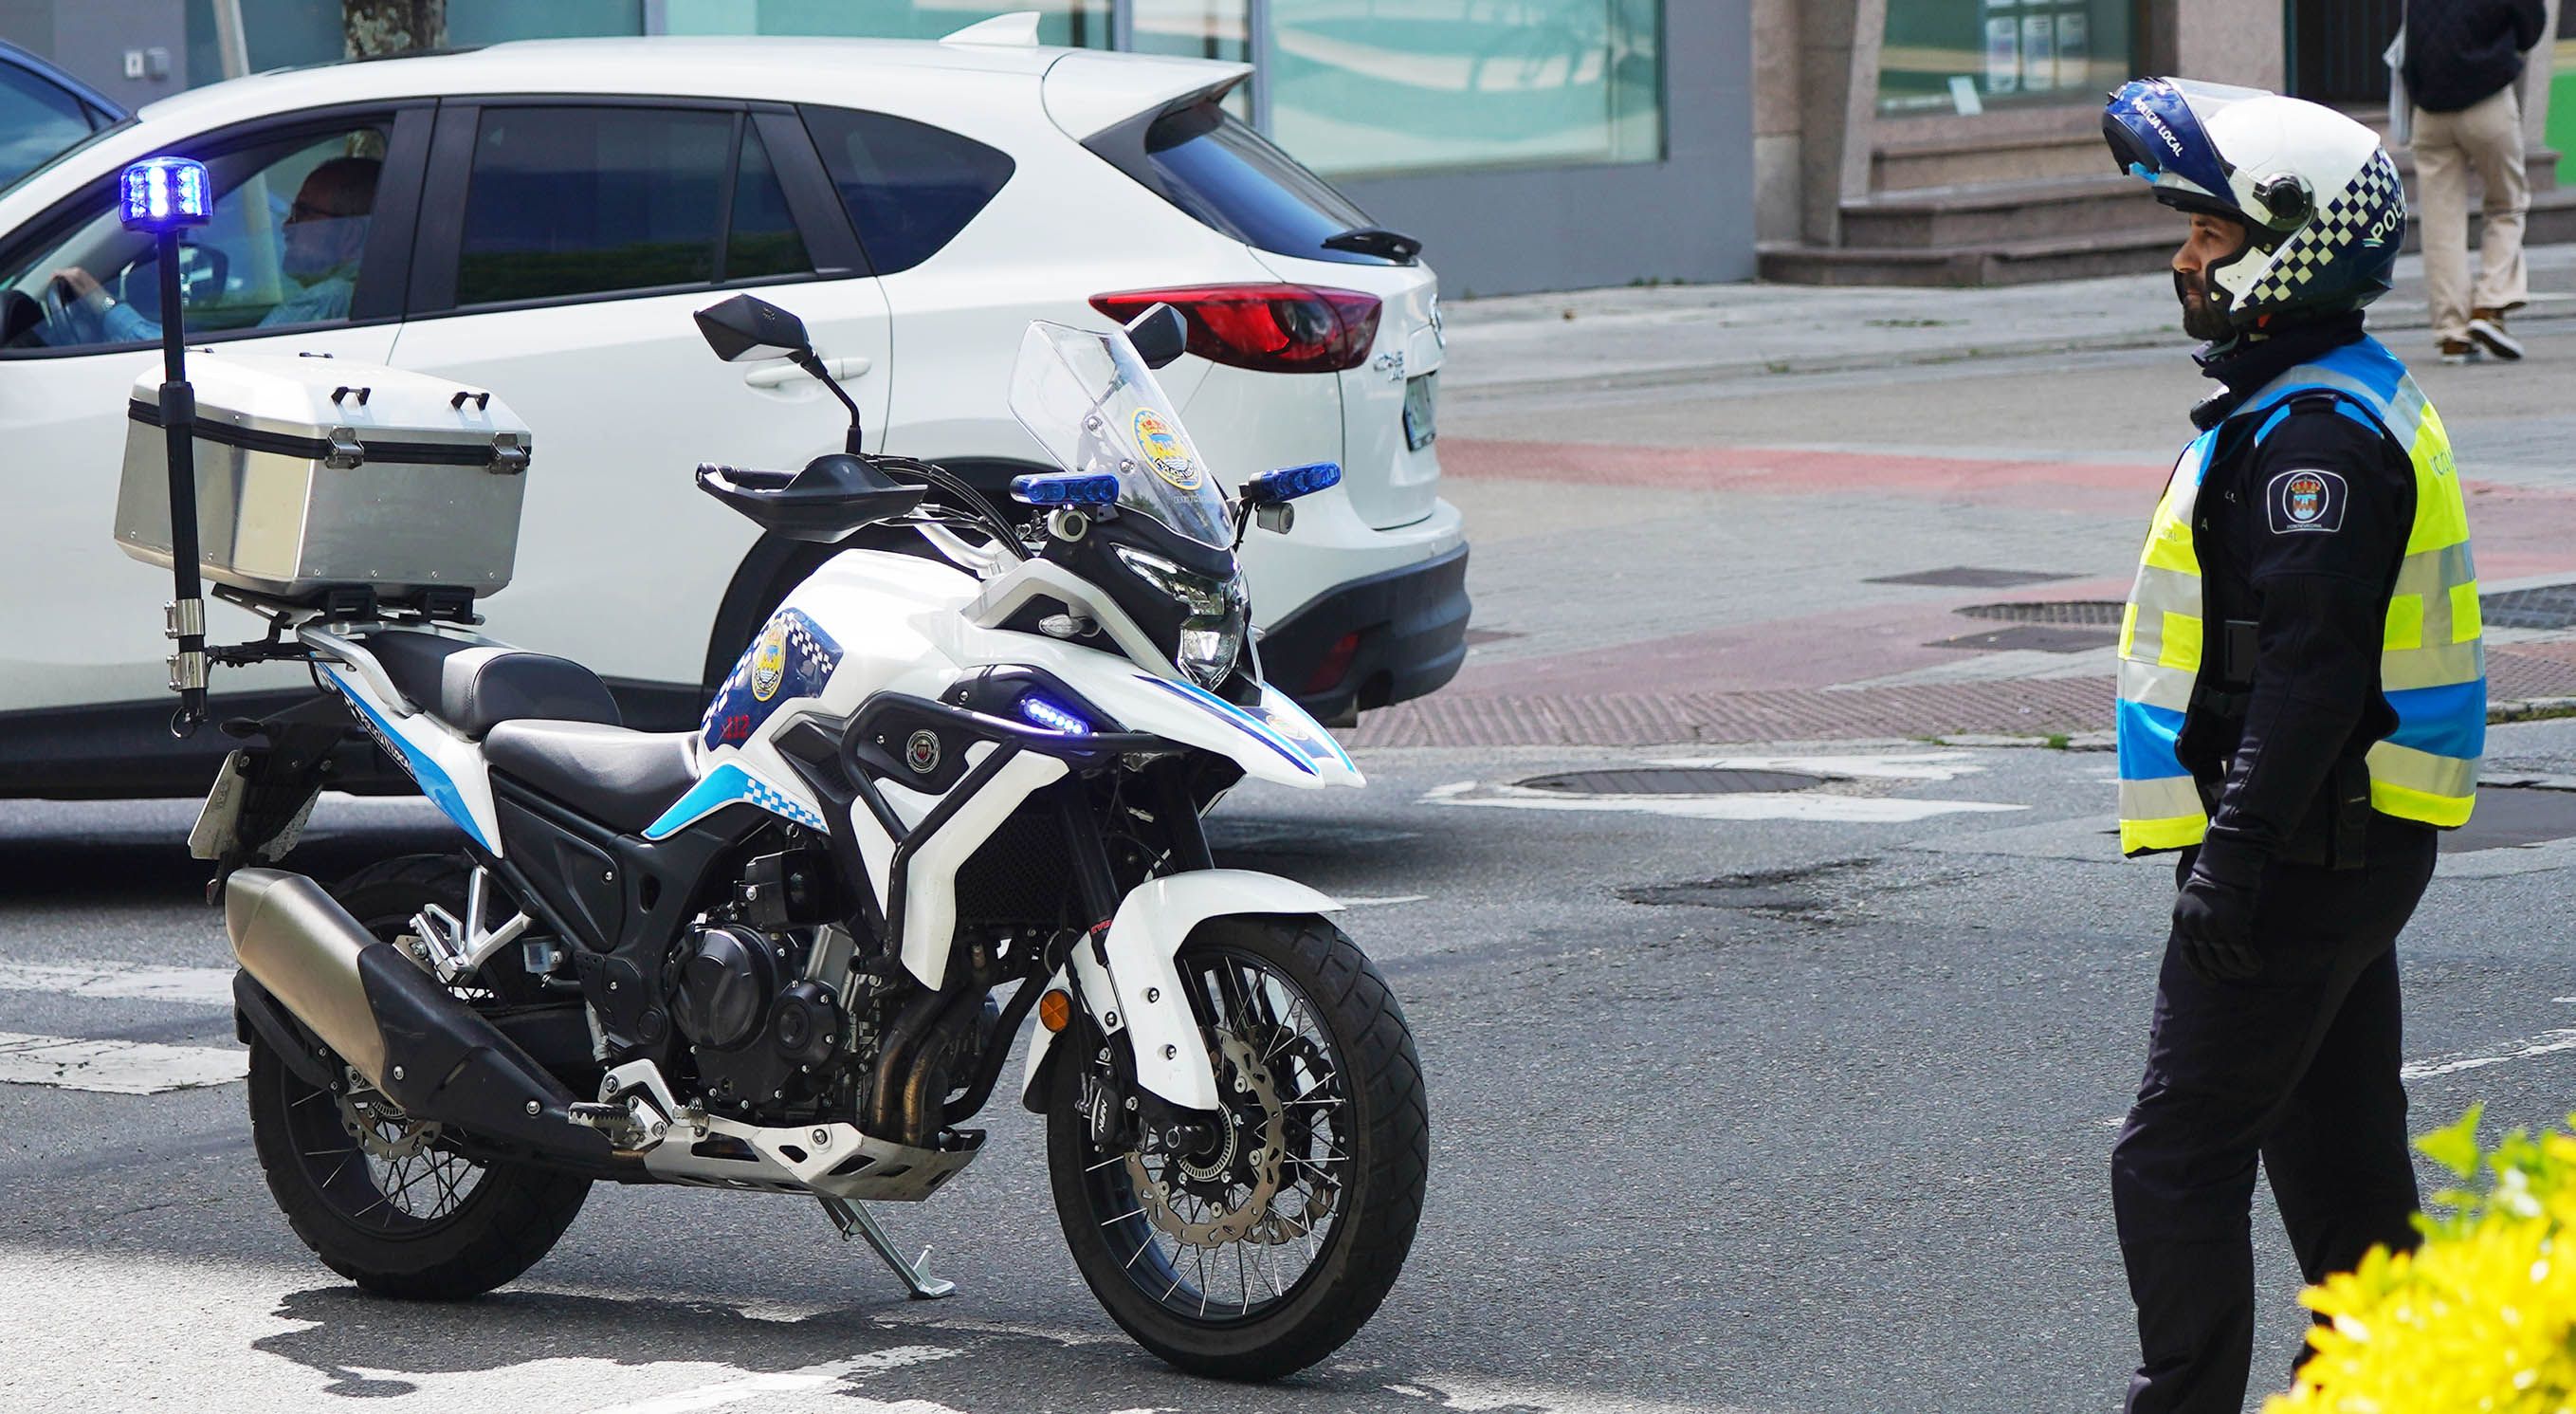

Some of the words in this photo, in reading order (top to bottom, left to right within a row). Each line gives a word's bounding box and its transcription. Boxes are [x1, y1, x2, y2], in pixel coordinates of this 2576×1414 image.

[2131, 97, 2162, 129] POLICIA
[2158, 125, 2183, 157] LOCAL
[2370, 186, 2406, 241] POLI
